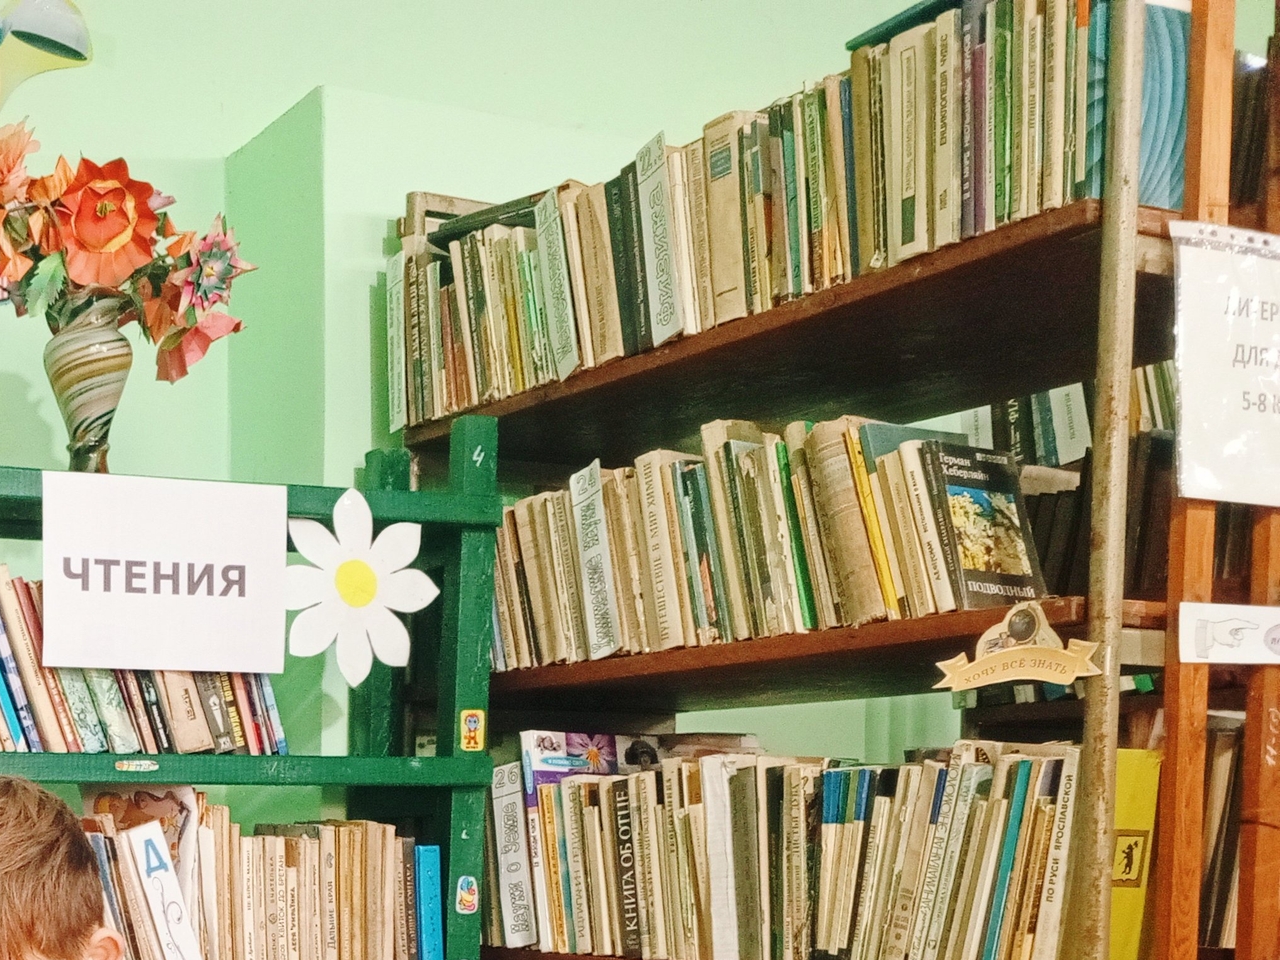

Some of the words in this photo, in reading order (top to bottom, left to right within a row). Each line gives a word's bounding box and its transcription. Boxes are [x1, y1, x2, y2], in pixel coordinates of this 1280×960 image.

[939, 34, 947, 66] ЧУДЕС
[939, 70, 947, 145] ЕНЦИКЛОПЕДІЯ
[645, 181, 675, 325] Физика
[1242, 391, 1266, 413] 5-8
[939, 452, 972, 467] Герман
[941, 465, 990, 481] Хеберляйн
[642, 462, 656, 508] ХИМИИ
[647, 510, 660, 538] МИР
[651, 542, 660, 551] В
[63, 556, 247, 598] ЧТЕНИЯ
[967, 581, 1036, 598] ПОДВОДНЫЙ
[654, 556, 670, 641] ПУТЕШЕСТВИЕ
[963, 666, 996, 684] ХОЧУ
[1001, 659, 1025, 673] ВСЁ
[1029, 662, 1068, 675] ЗНАТЬ
[500, 801, 520, 855] Земле
[615, 790, 631, 839] ОТЦЕ
[1053, 773, 1073, 851] ЯРОСЛАВСКОЙ
[920, 836, 945, 911] ЗАНИМАТЕЛЬНАЯ
[936, 753, 962, 833] ЭНТОМОЛОГИЯ
[619, 843, 633, 867] ОБ
[1048, 857, 1059, 885] РУСИ
[278, 889, 285, 902] ДО
[508, 880, 531, 935] Науки
[621, 870, 638, 930] КНИГА
[1046, 887, 1054, 902] ПО
[277, 905, 285, 937] КВИТОК
